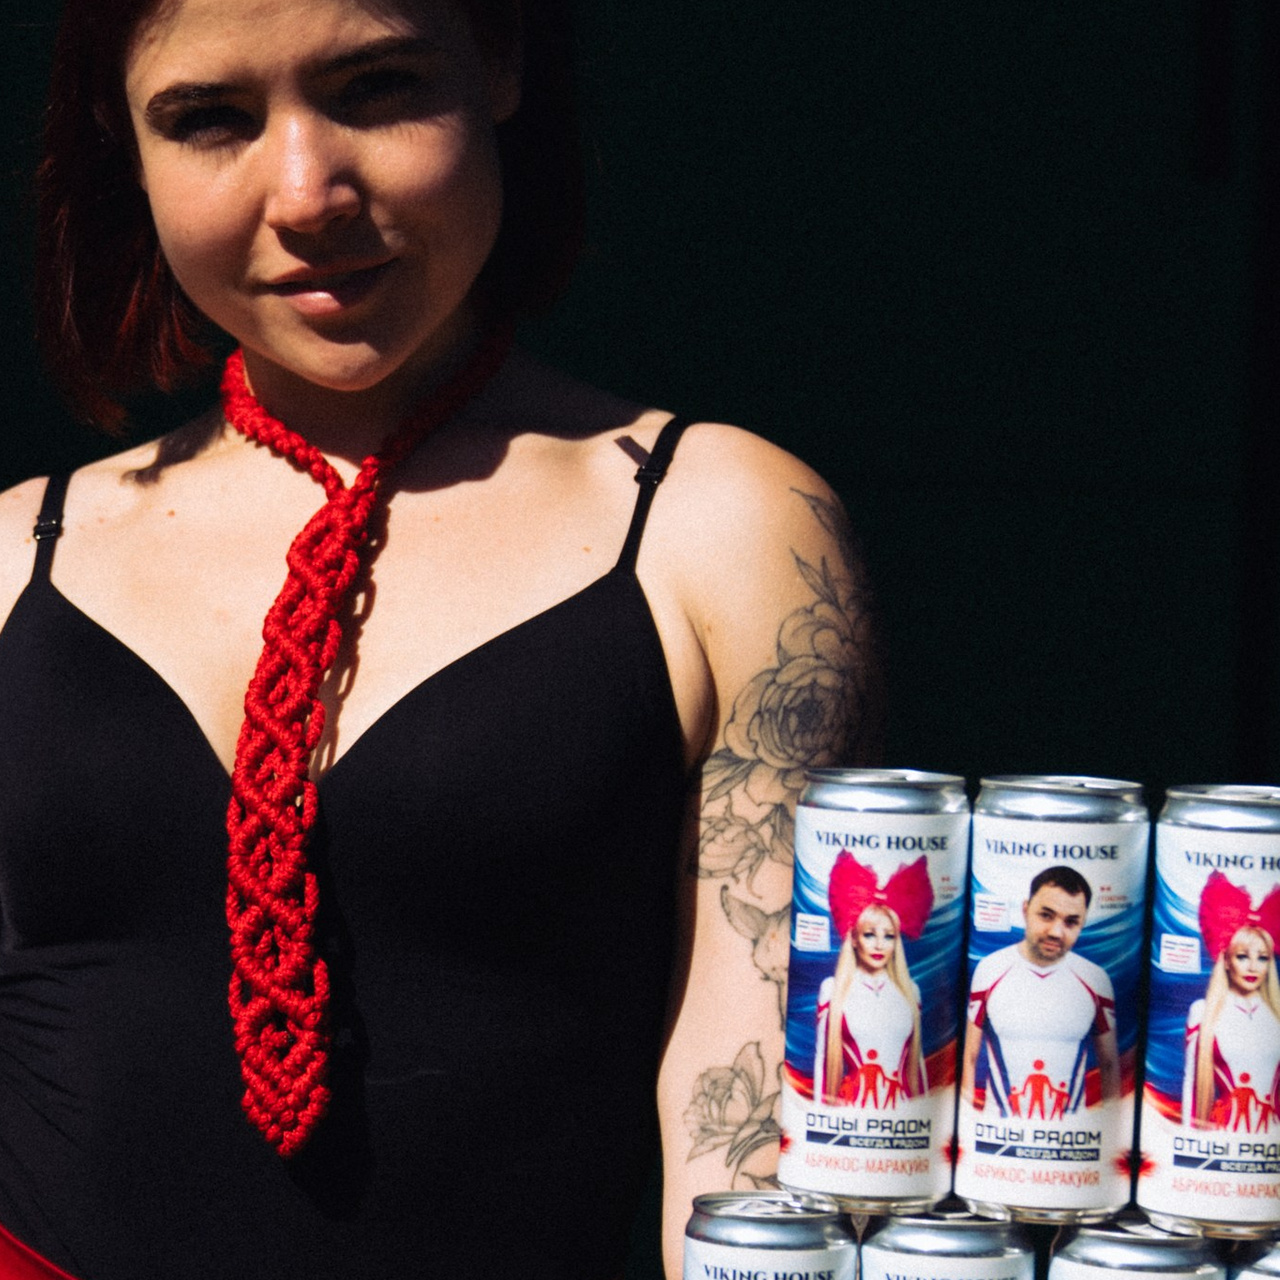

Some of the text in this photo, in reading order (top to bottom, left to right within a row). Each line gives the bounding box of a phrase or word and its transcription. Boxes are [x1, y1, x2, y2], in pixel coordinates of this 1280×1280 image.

[816, 831, 948, 851] VIKING HOUSE
[985, 840, 1119, 860] VIKING HOUSE
[1185, 852, 1254, 871] VIKING
[806, 1113, 931, 1137] ОТЦЫ РЯДОМ
[975, 1123, 1101, 1148] ОТЦЫ РЯДОМ
[1173, 1137, 1230, 1157] ОТЦЫ
